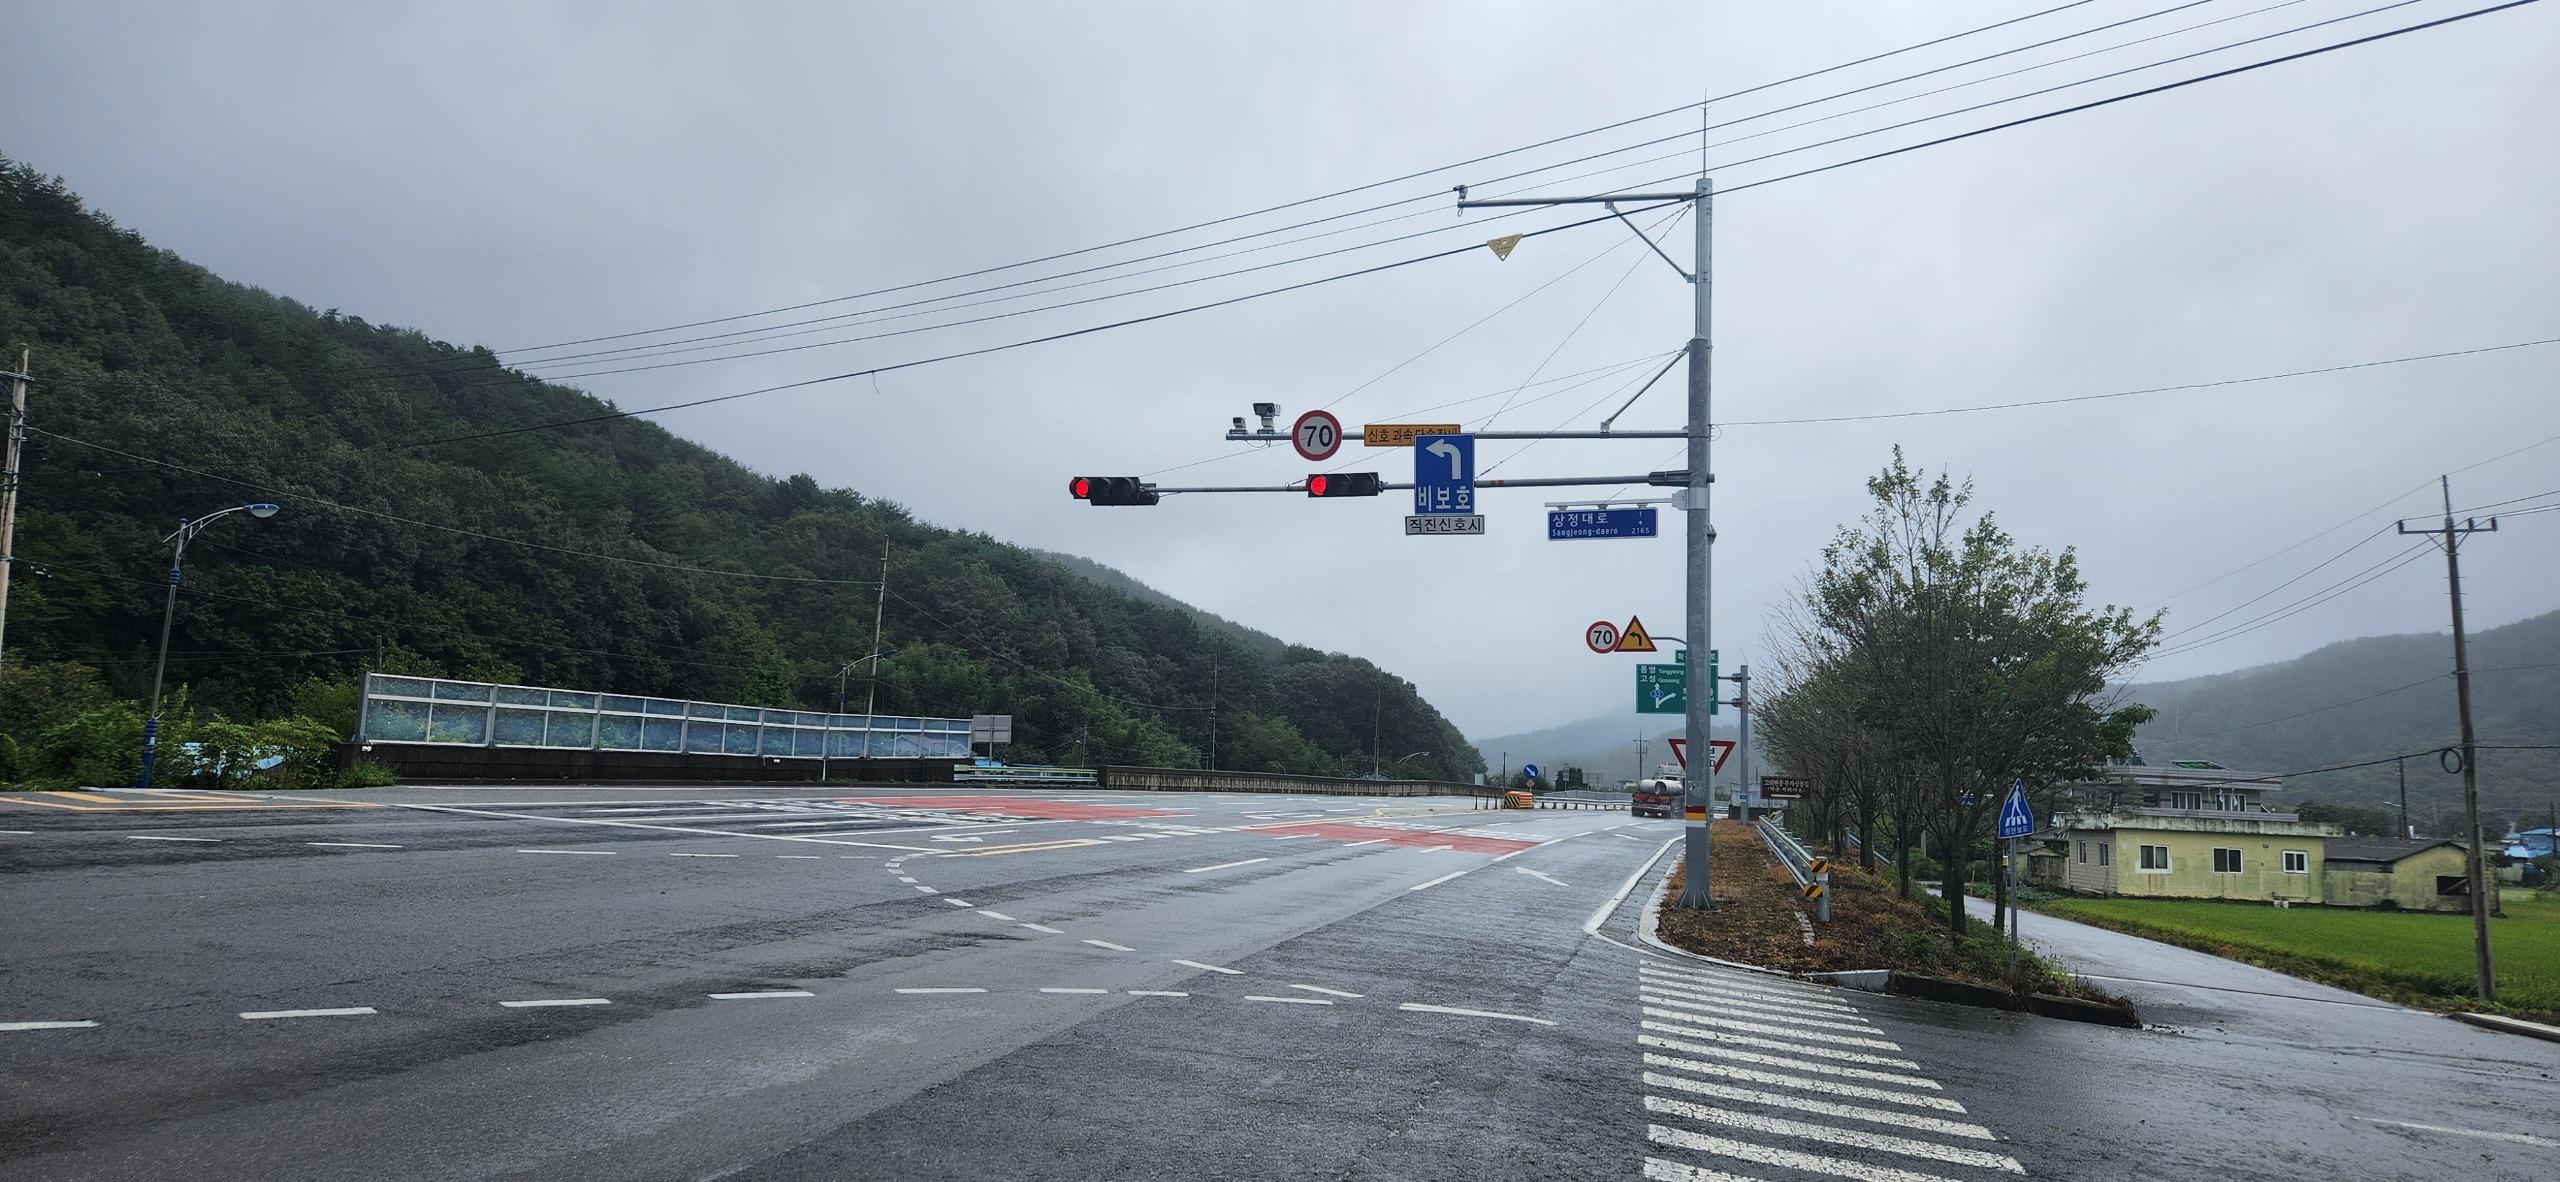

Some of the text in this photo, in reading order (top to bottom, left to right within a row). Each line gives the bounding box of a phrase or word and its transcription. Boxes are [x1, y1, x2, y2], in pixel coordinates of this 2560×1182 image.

[1304, 425, 1333, 447] 70
[1368, 428, 1389, 443] 신호
[1418, 485, 1471, 512] 비보호
[1409, 517, 1480, 532] 직진신호시
[1553, 512, 1609, 528] 상정대로
[1552, 527, 1618, 537] Sangjeong-daero
[1631, 527, 1650, 535] 2165
[1593, 630, 1612, 645] 70
[1640, 675, 1656, 683] 고성
[2005, 826, 2029, 835] 횡단보도
